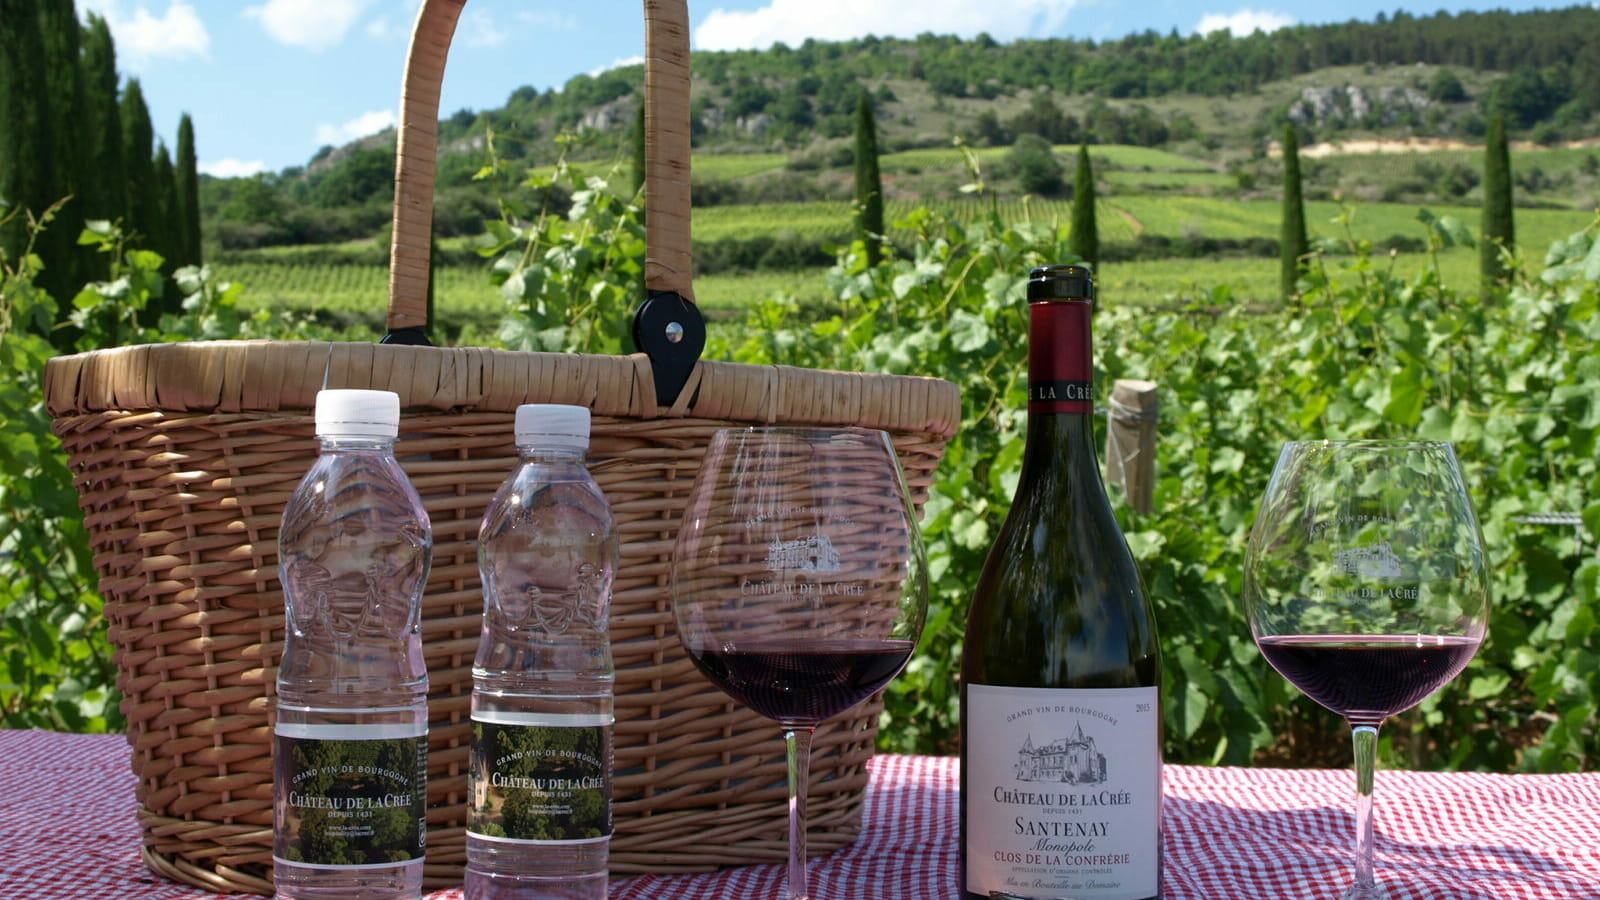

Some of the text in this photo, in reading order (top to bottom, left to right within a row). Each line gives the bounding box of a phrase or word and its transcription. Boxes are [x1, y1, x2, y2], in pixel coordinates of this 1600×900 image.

[1039, 387, 1056, 400] LA
[799, 583, 816, 594] DE
[1362, 588, 1378, 598] DE
[1395, 586, 1419, 600] CRÉ
[1007, 709, 1033, 723] GRAND
[1069, 706, 1119, 726] BOURGOGNE
[496, 752, 523, 766] GRAND
[292, 765, 409, 787] GRAND VIN DE BOURGOGNE
[492, 771, 545, 789] CHÂTEAU
[548, 778, 565, 790] DE
[289, 791, 343, 809] CHÂTEAU
[347, 797, 364, 809] DE
[994, 786, 1055, 807] CHÂTEAU
[1059, 794, 1079, 806] DE
[1014, 816, 1110, 837] SANTENAY
[1029, 838, 1097, 857] Monopole
[994, 851, 1131, 866] CLOS DE LA CONFRÉRIE
[1003, 876, 1018, 887] Mis
[1032, 879, 1069, 889] Bouteille
[1084, 880, 1121, 889] Domaine
